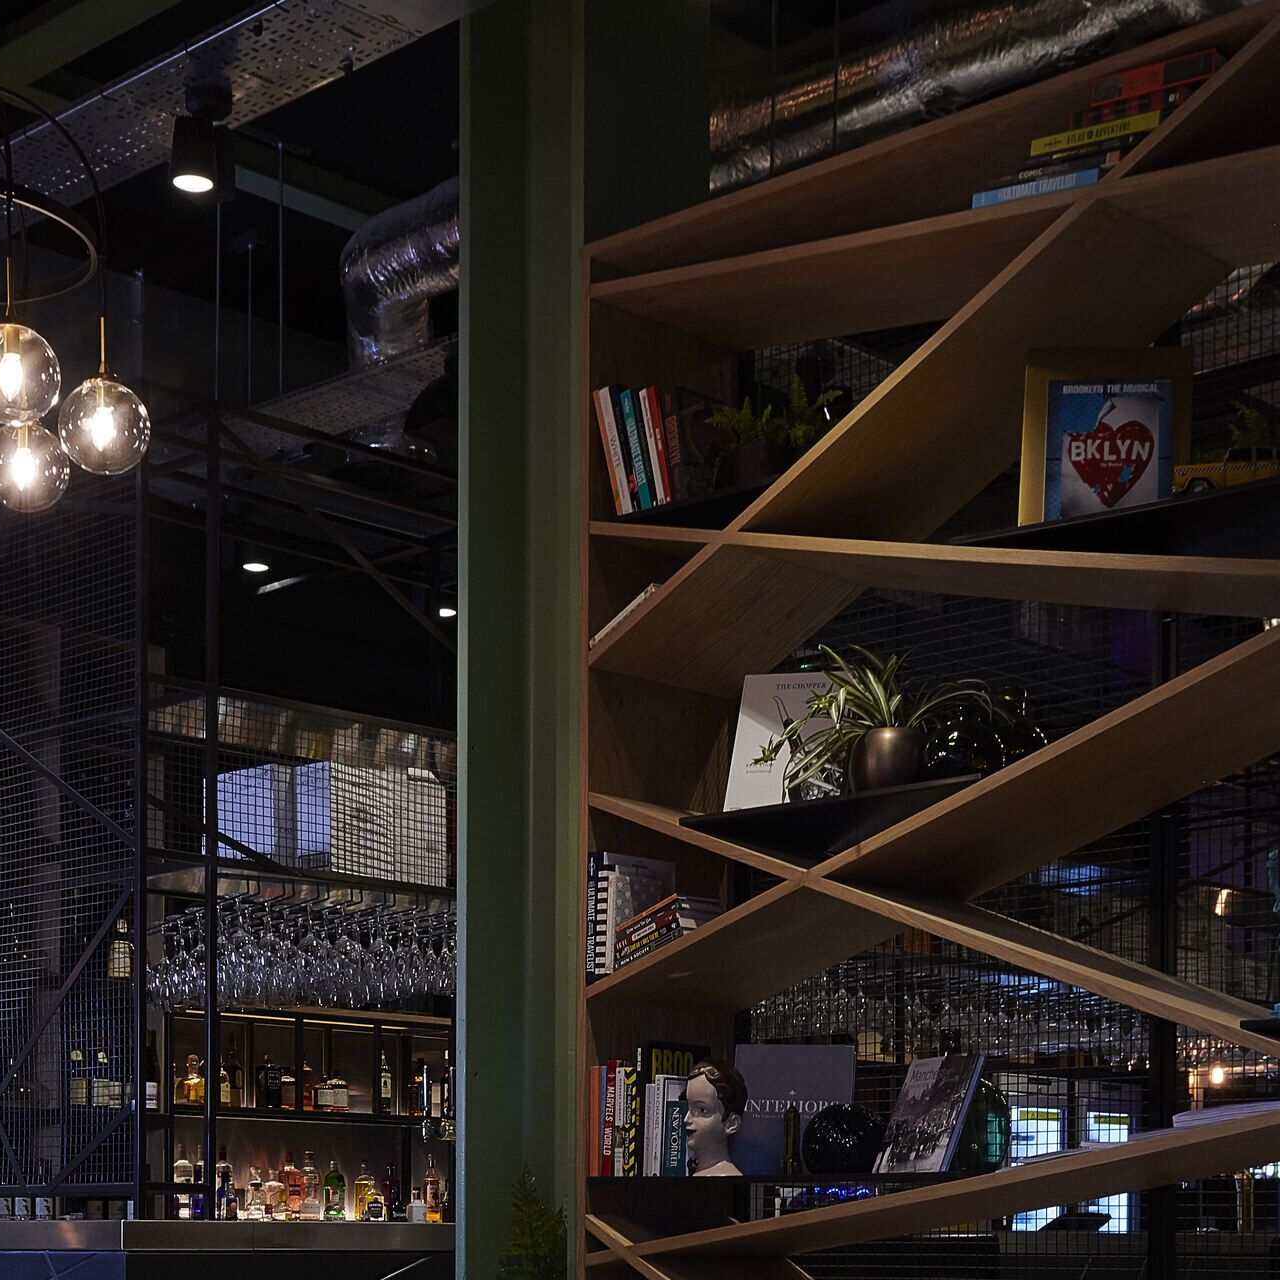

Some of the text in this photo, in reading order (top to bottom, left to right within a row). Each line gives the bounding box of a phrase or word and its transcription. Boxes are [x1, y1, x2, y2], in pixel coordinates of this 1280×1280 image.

[1018, 167, 1043, 180] COMIC
[1062, 383, 1159, 394] BROOKLYN THE MUSICAL
[608, 436, 622, 469] WHITE
[1070, 439, 1152, 463] BKLYN
[776, 681, 827, 690] THE CHOPPER
[587, 887, 596, 923] ULTIMATE
[586, 935, 595, 973] TRAVELIST
[602, 1085, 616, 1157] MARVELS WORLD
[669, 1106, 680, 1168] NEW YORKER
